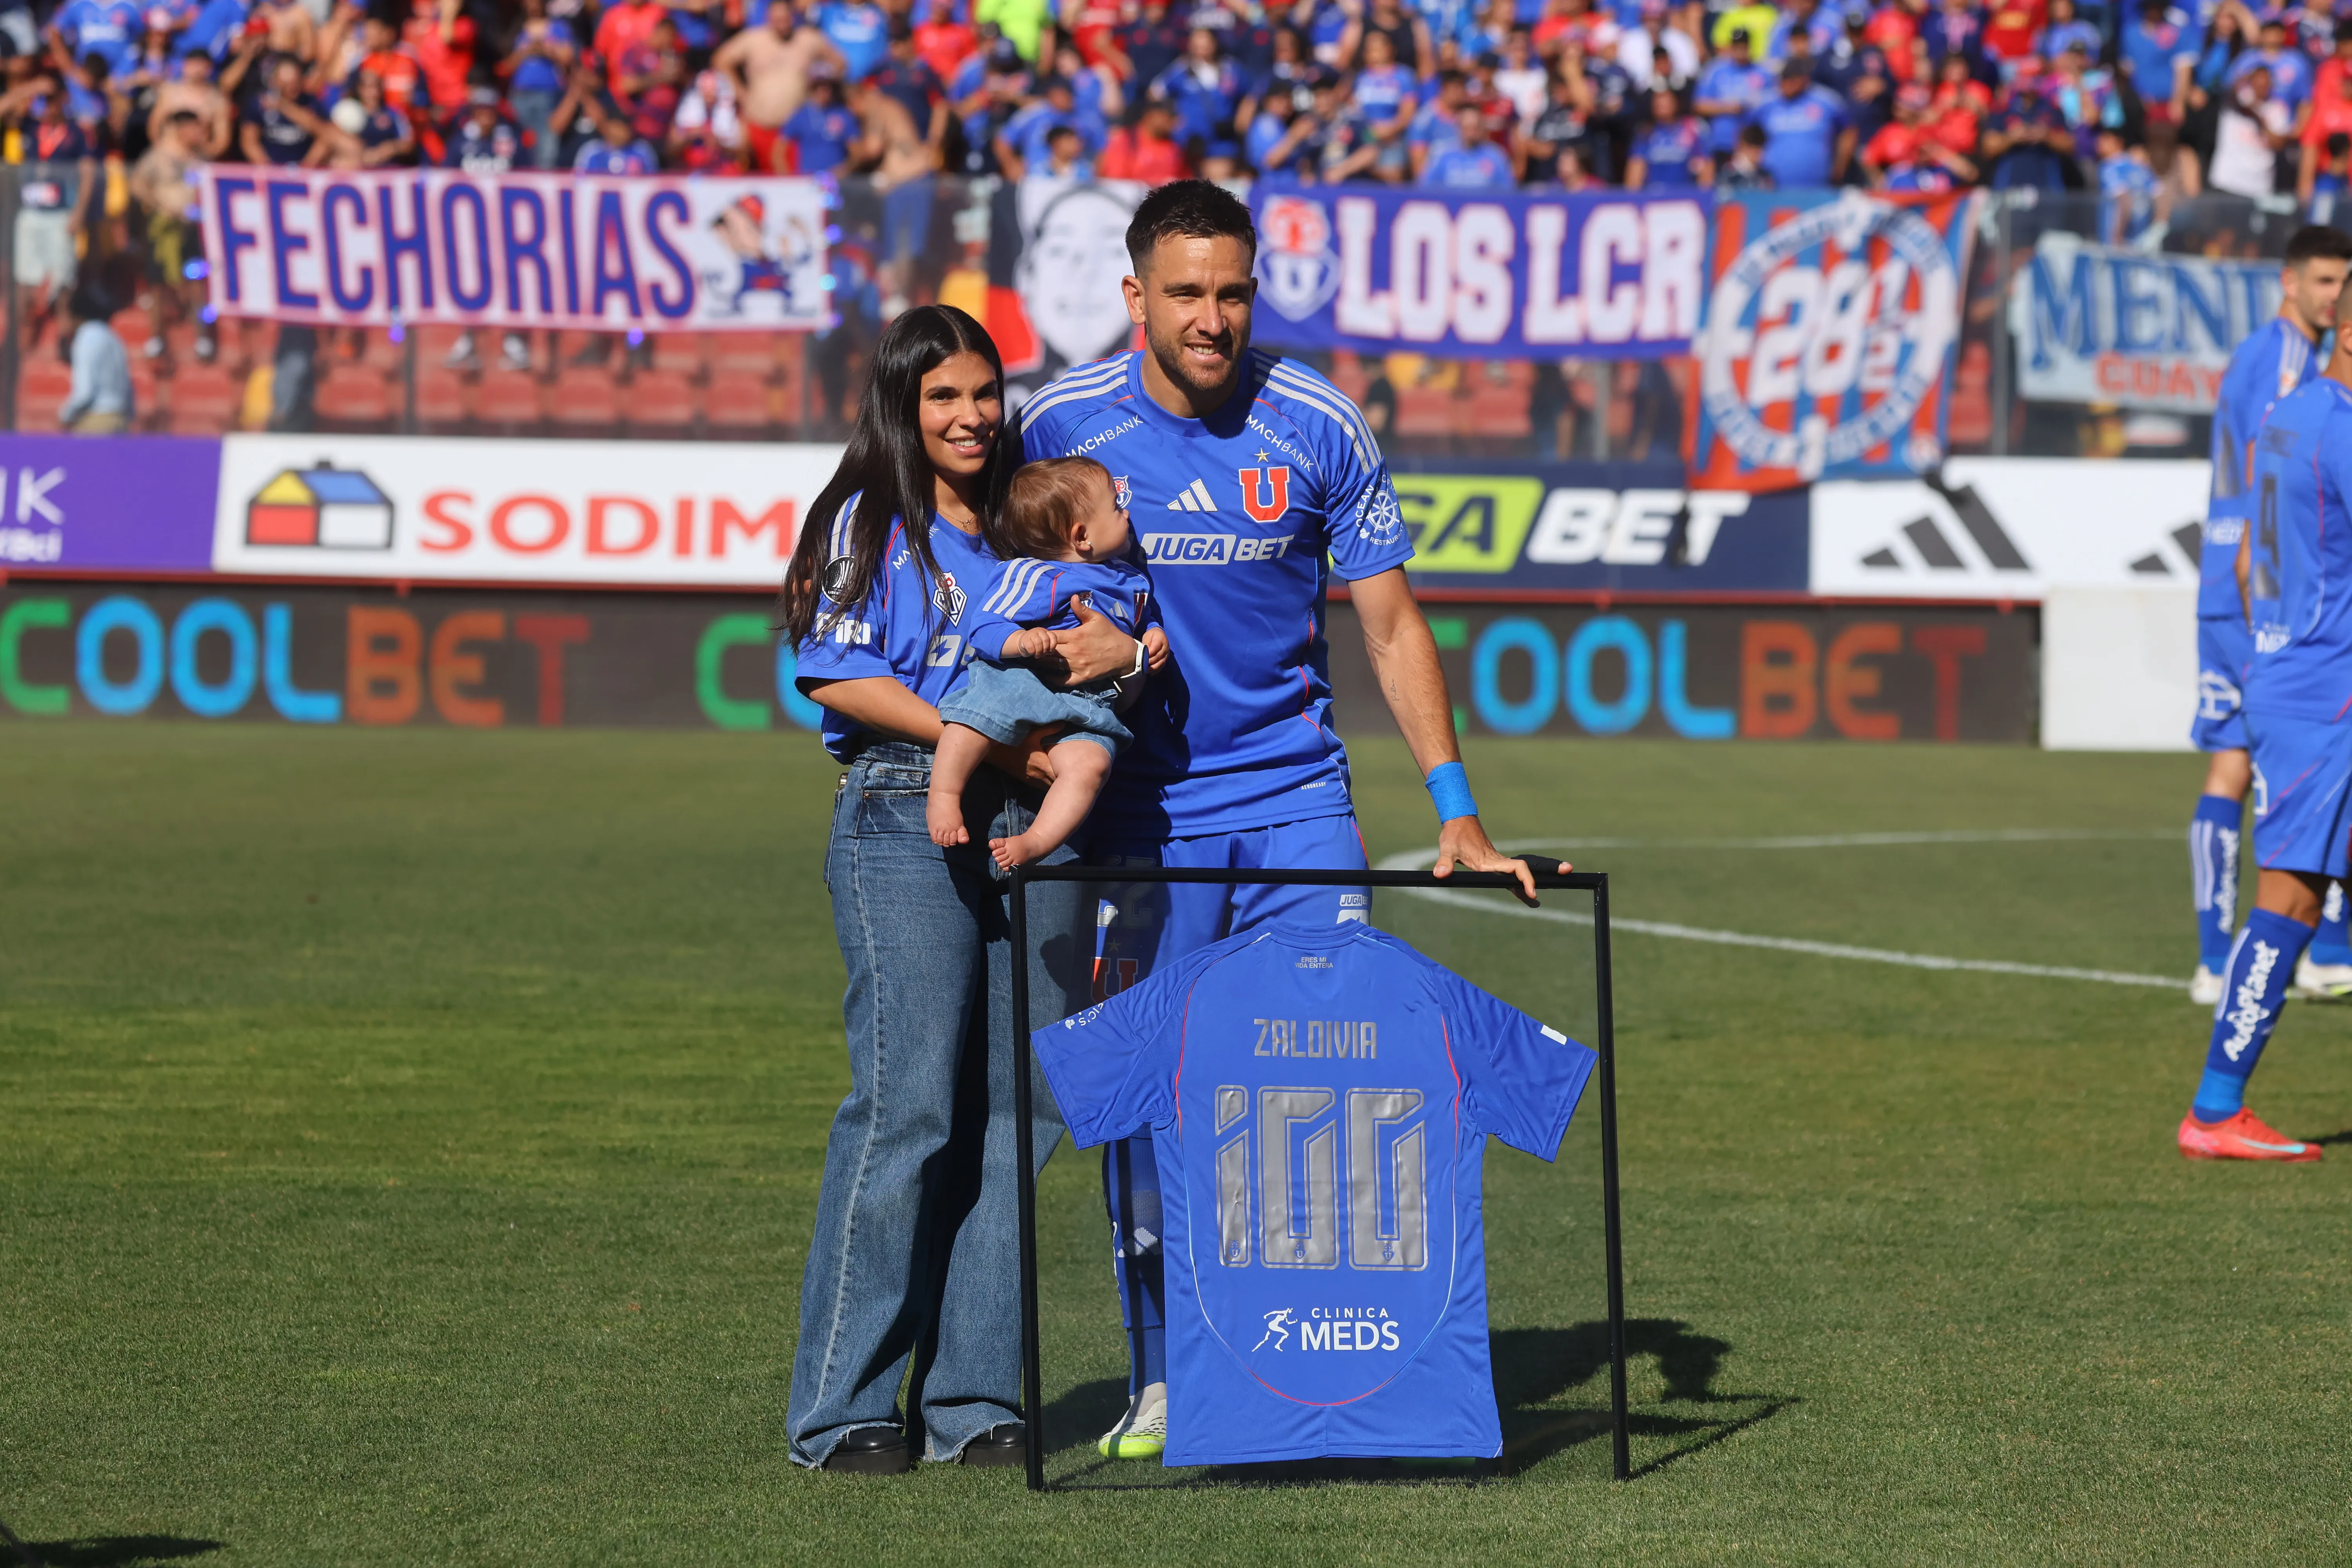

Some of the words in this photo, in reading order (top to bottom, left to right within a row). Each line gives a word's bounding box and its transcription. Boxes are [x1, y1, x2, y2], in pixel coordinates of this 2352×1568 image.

[214, 176, 695, 319] FECHORIAS
[1336, 196, 1515, 344] LOS
[1523, 199, 1705, 345] LCR
[1065, 414, 1143, 457] MACHBANK
[1245, 414, 1314, 472] MACHBANK
[1238, 466, 1290, 523] U
[1355, 485, 1375, 527] OCEAN
[418, 489, 797, 558] SODIM
[1369, 523, 1405, 546] RESTAURANT
[0, 594, 591, 728] COOLBET
[1301, 782, 1326, 790] AEROREADY
[1254, 1018, 1377, 1059] ZALDIVIA
[1215, 1085, 1428, 1272] 100
[1301, 1321, 1400, 1351] MEDS
[1311, 1307, 1389, 1318] CLINICA
